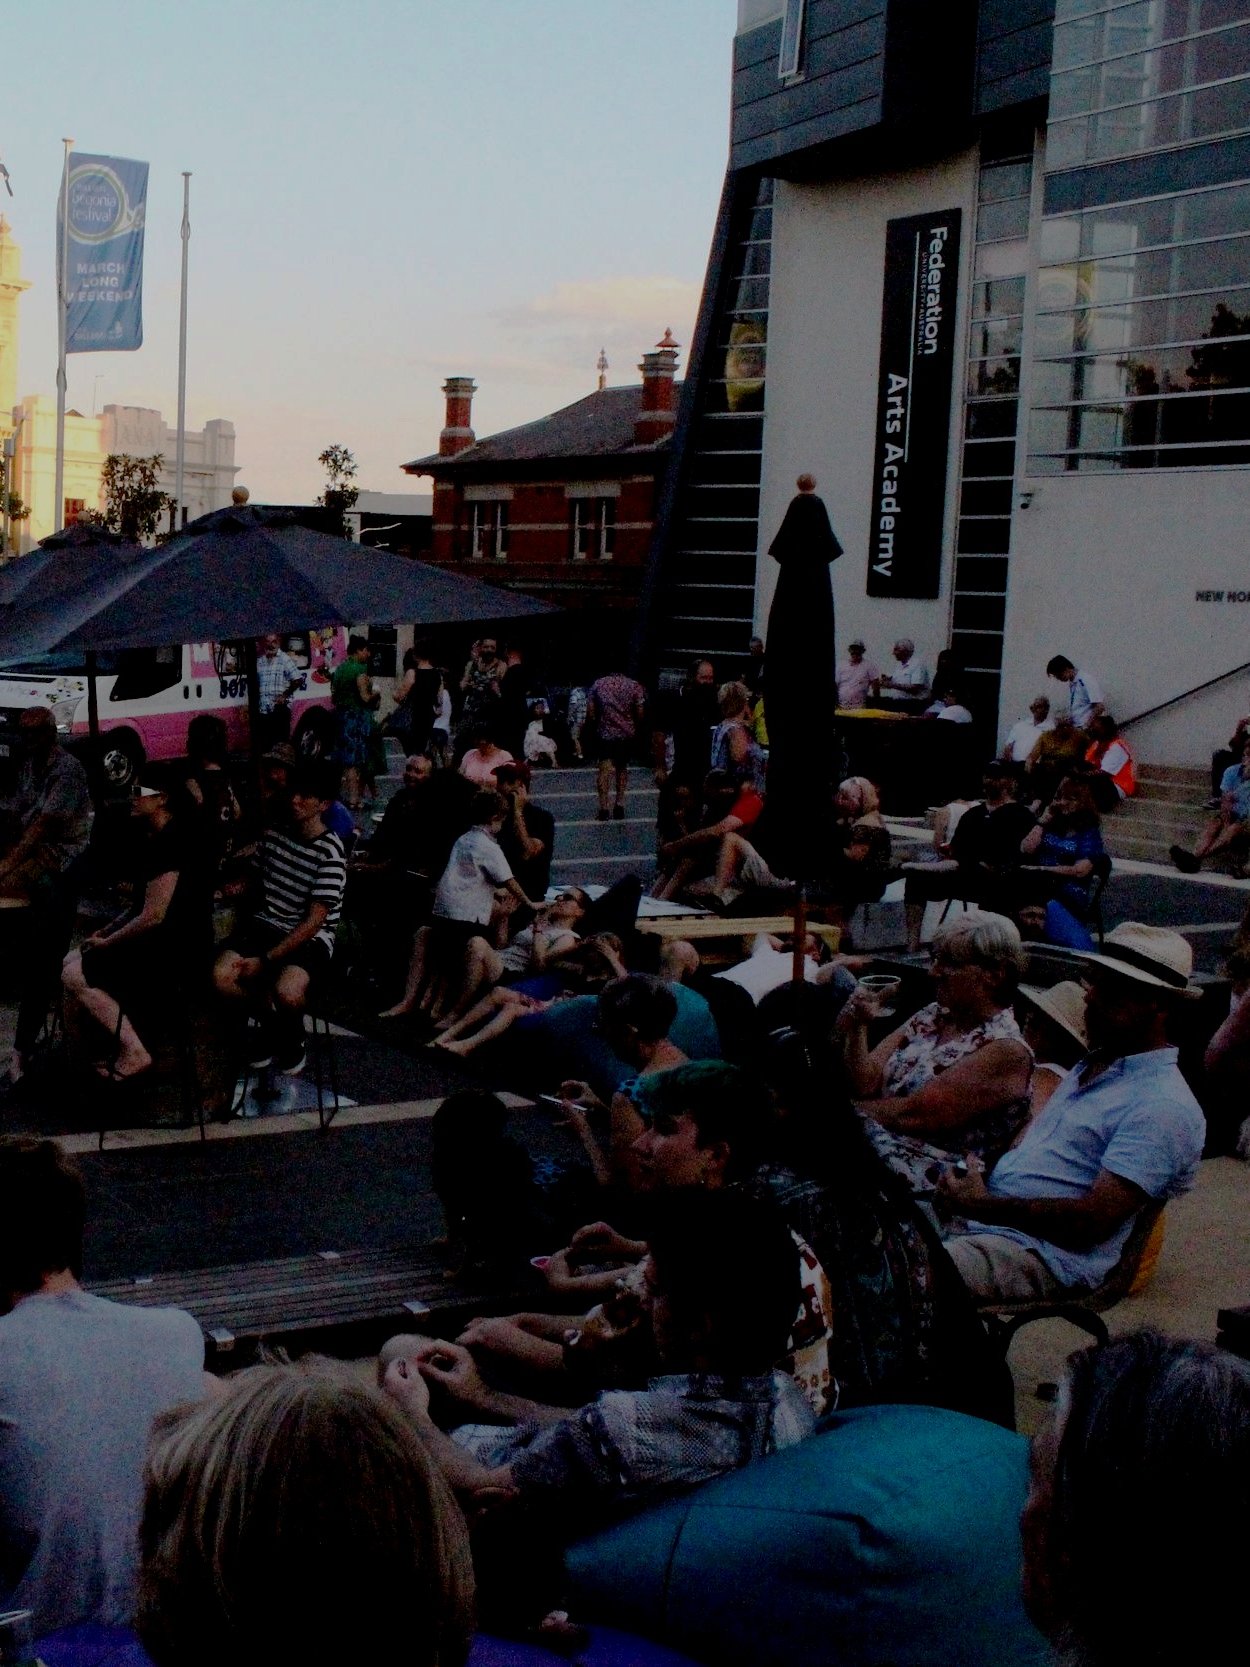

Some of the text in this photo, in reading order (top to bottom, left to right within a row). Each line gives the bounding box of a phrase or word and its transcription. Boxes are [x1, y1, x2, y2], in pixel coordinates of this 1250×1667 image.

[77, 263, 125, 275] MARCH
[82, 276, 119, 288] LONG
[923, 226, 948, 355] Federation
[872, 372, 909, 577] Arts Academy
